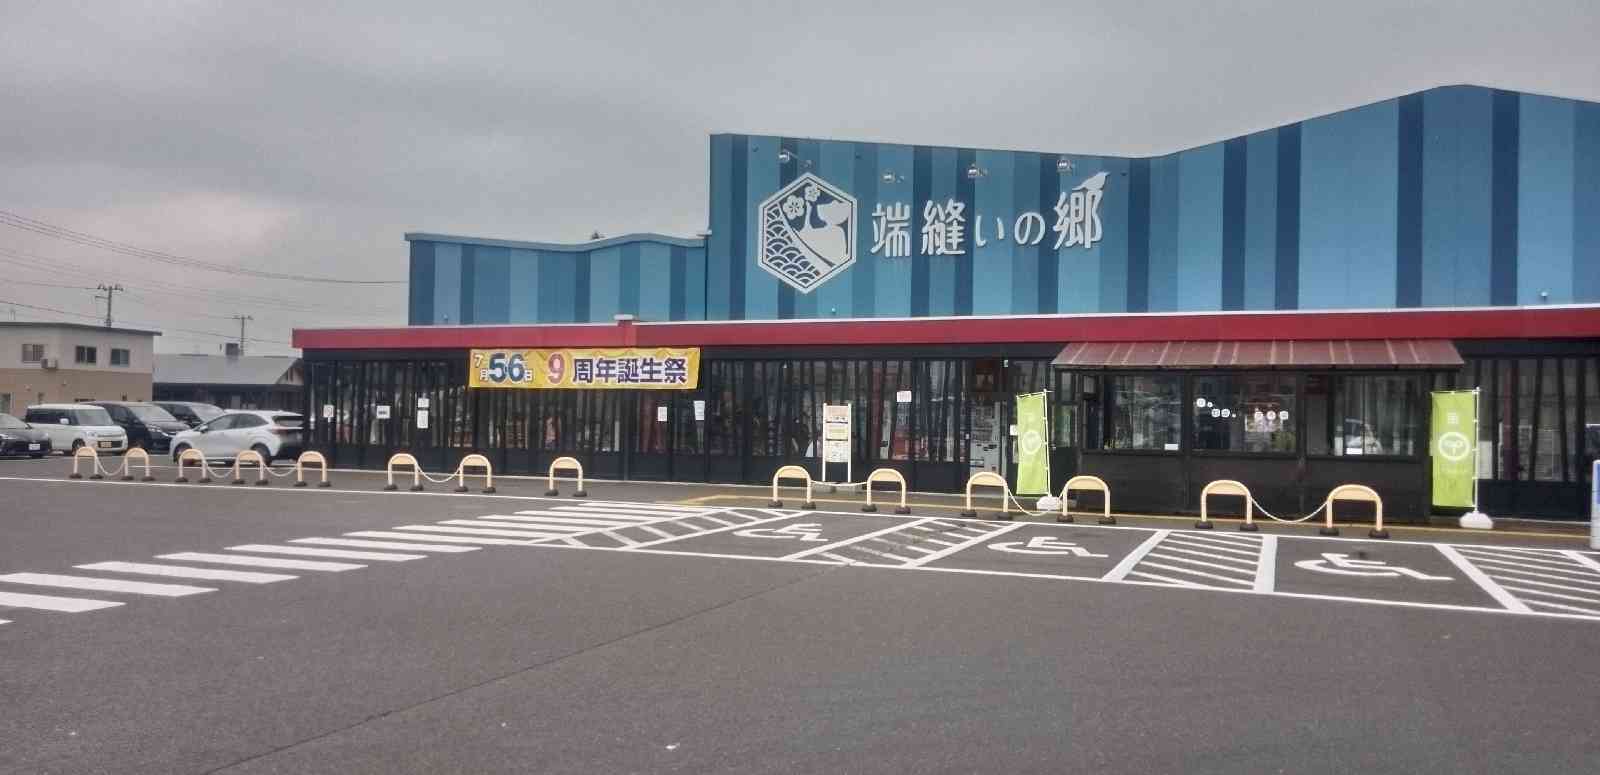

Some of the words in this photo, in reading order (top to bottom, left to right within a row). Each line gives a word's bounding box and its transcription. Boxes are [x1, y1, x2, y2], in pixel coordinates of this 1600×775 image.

[871, 173, 1107, 257] 端縫いの郷
